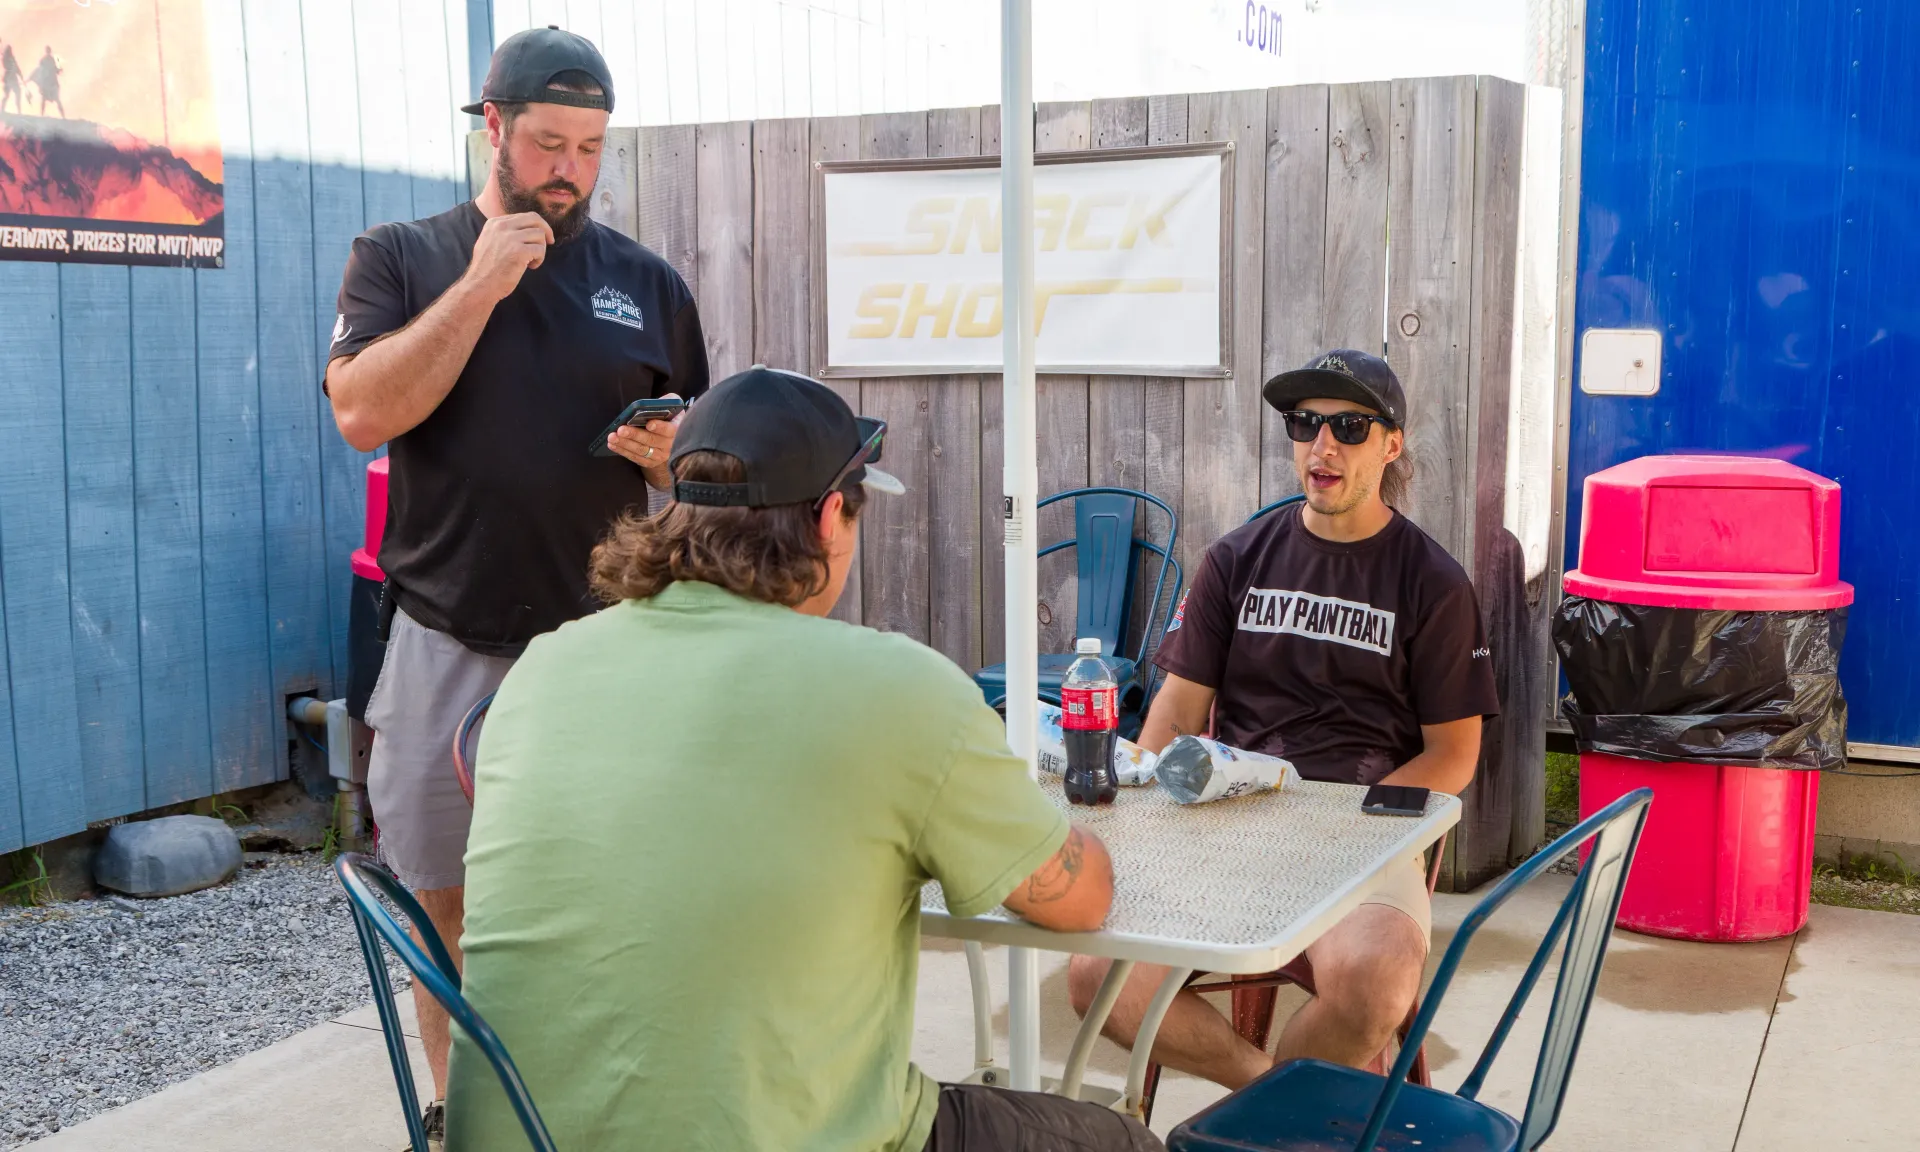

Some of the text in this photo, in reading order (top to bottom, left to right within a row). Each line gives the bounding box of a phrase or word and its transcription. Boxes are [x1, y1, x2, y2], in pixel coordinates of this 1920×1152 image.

[1238, 0, 1282, 57] .com
[72, 230, 126, 252] PRIZES
[127, 233, 156, 254] FOR
[157, 234, 224, 259] MVT/MVP
[593, 298, 641, 320] HAMPSHIRE
[1243, 593, 1388, 649] PLAY PAINTBALL
